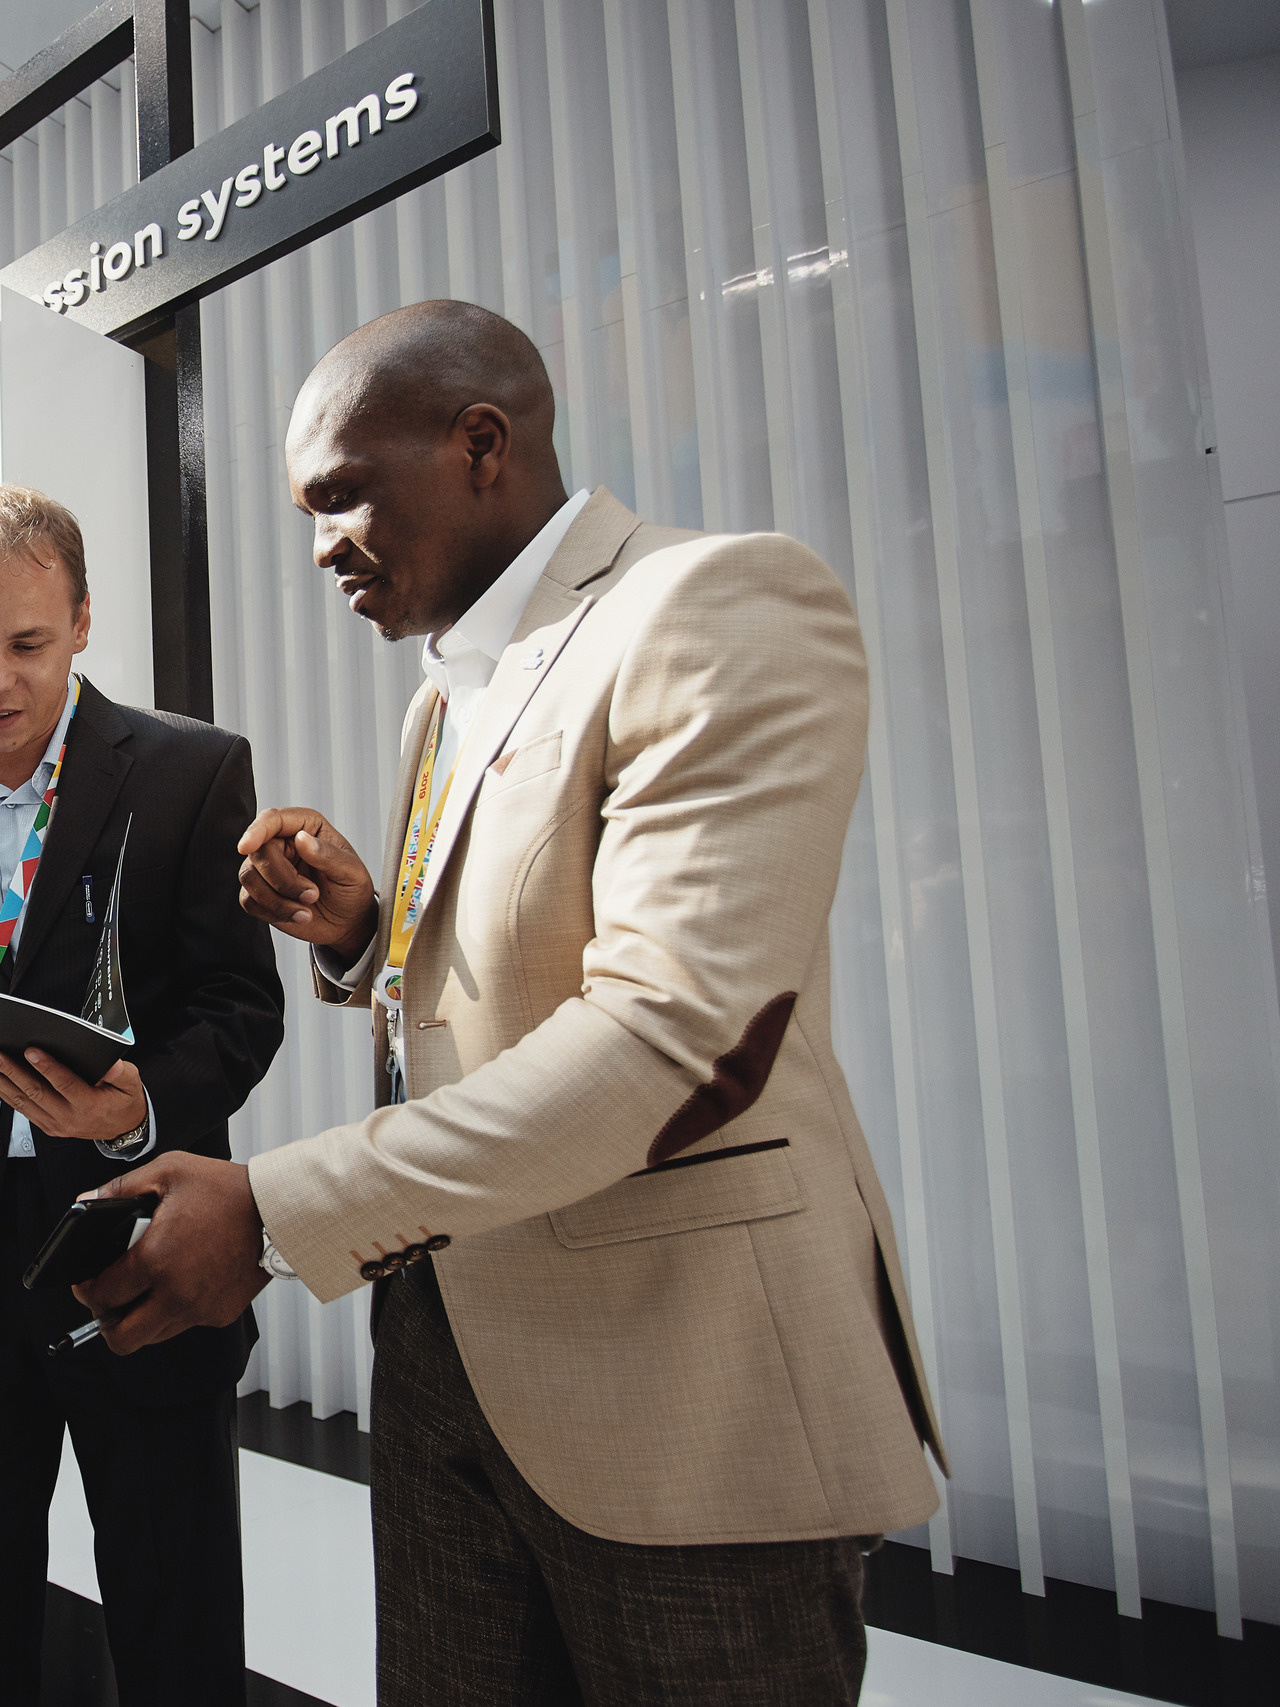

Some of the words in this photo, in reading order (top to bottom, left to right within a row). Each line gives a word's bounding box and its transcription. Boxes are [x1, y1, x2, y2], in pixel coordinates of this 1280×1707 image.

[31, 222, 163, 314] ssion
[177, 72, 419, 241] systems
[419, 771, 429, 800] 2019
